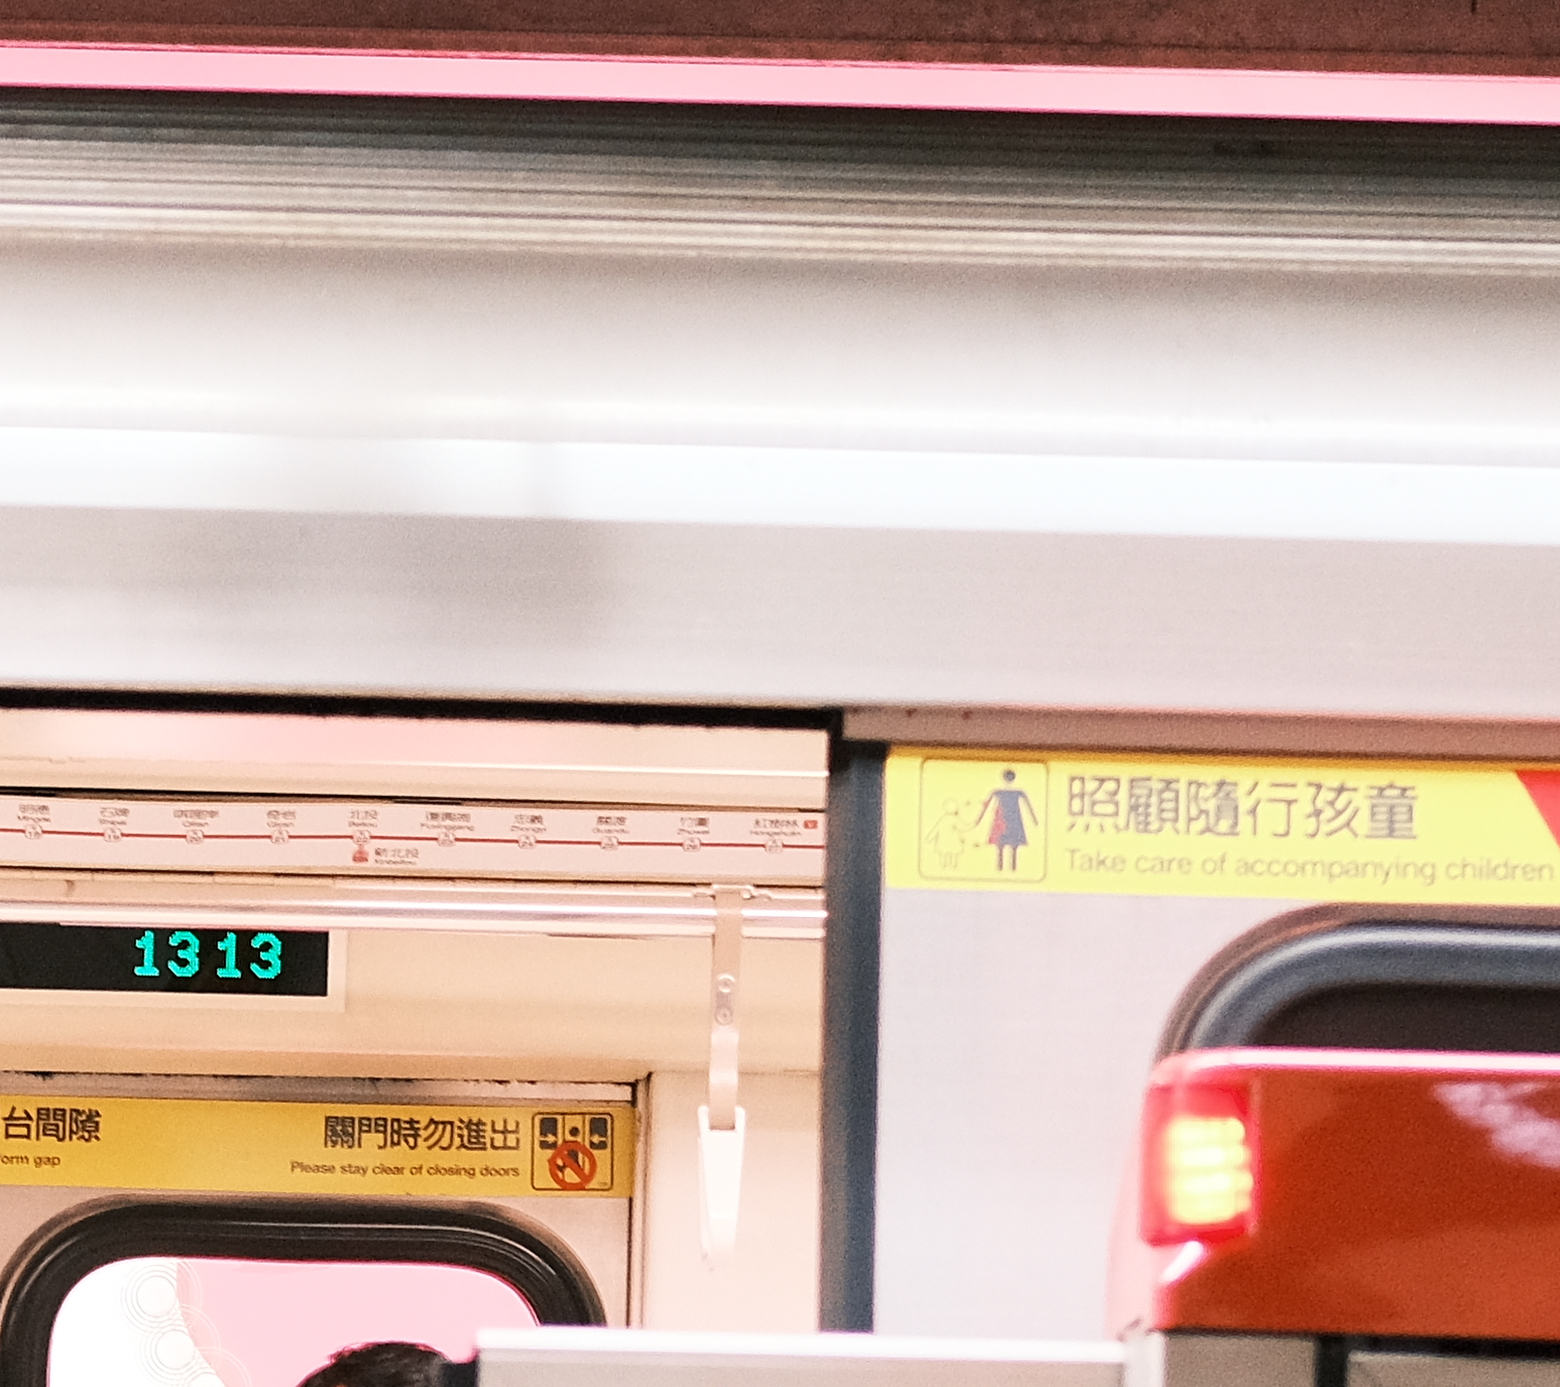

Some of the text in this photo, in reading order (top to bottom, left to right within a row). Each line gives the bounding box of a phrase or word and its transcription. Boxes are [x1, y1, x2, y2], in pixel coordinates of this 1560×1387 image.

[1066, 775, 1419, 841] 照顧隨行孩童
[1066, 848, 1555, 887] Take care of accompanying children
[324, 1115, 520, 1152] 關門時勿進出
[33, 1156, 61, 1171] gap
[290, 1161, 520, 1181] Please stay clear of closing doors
